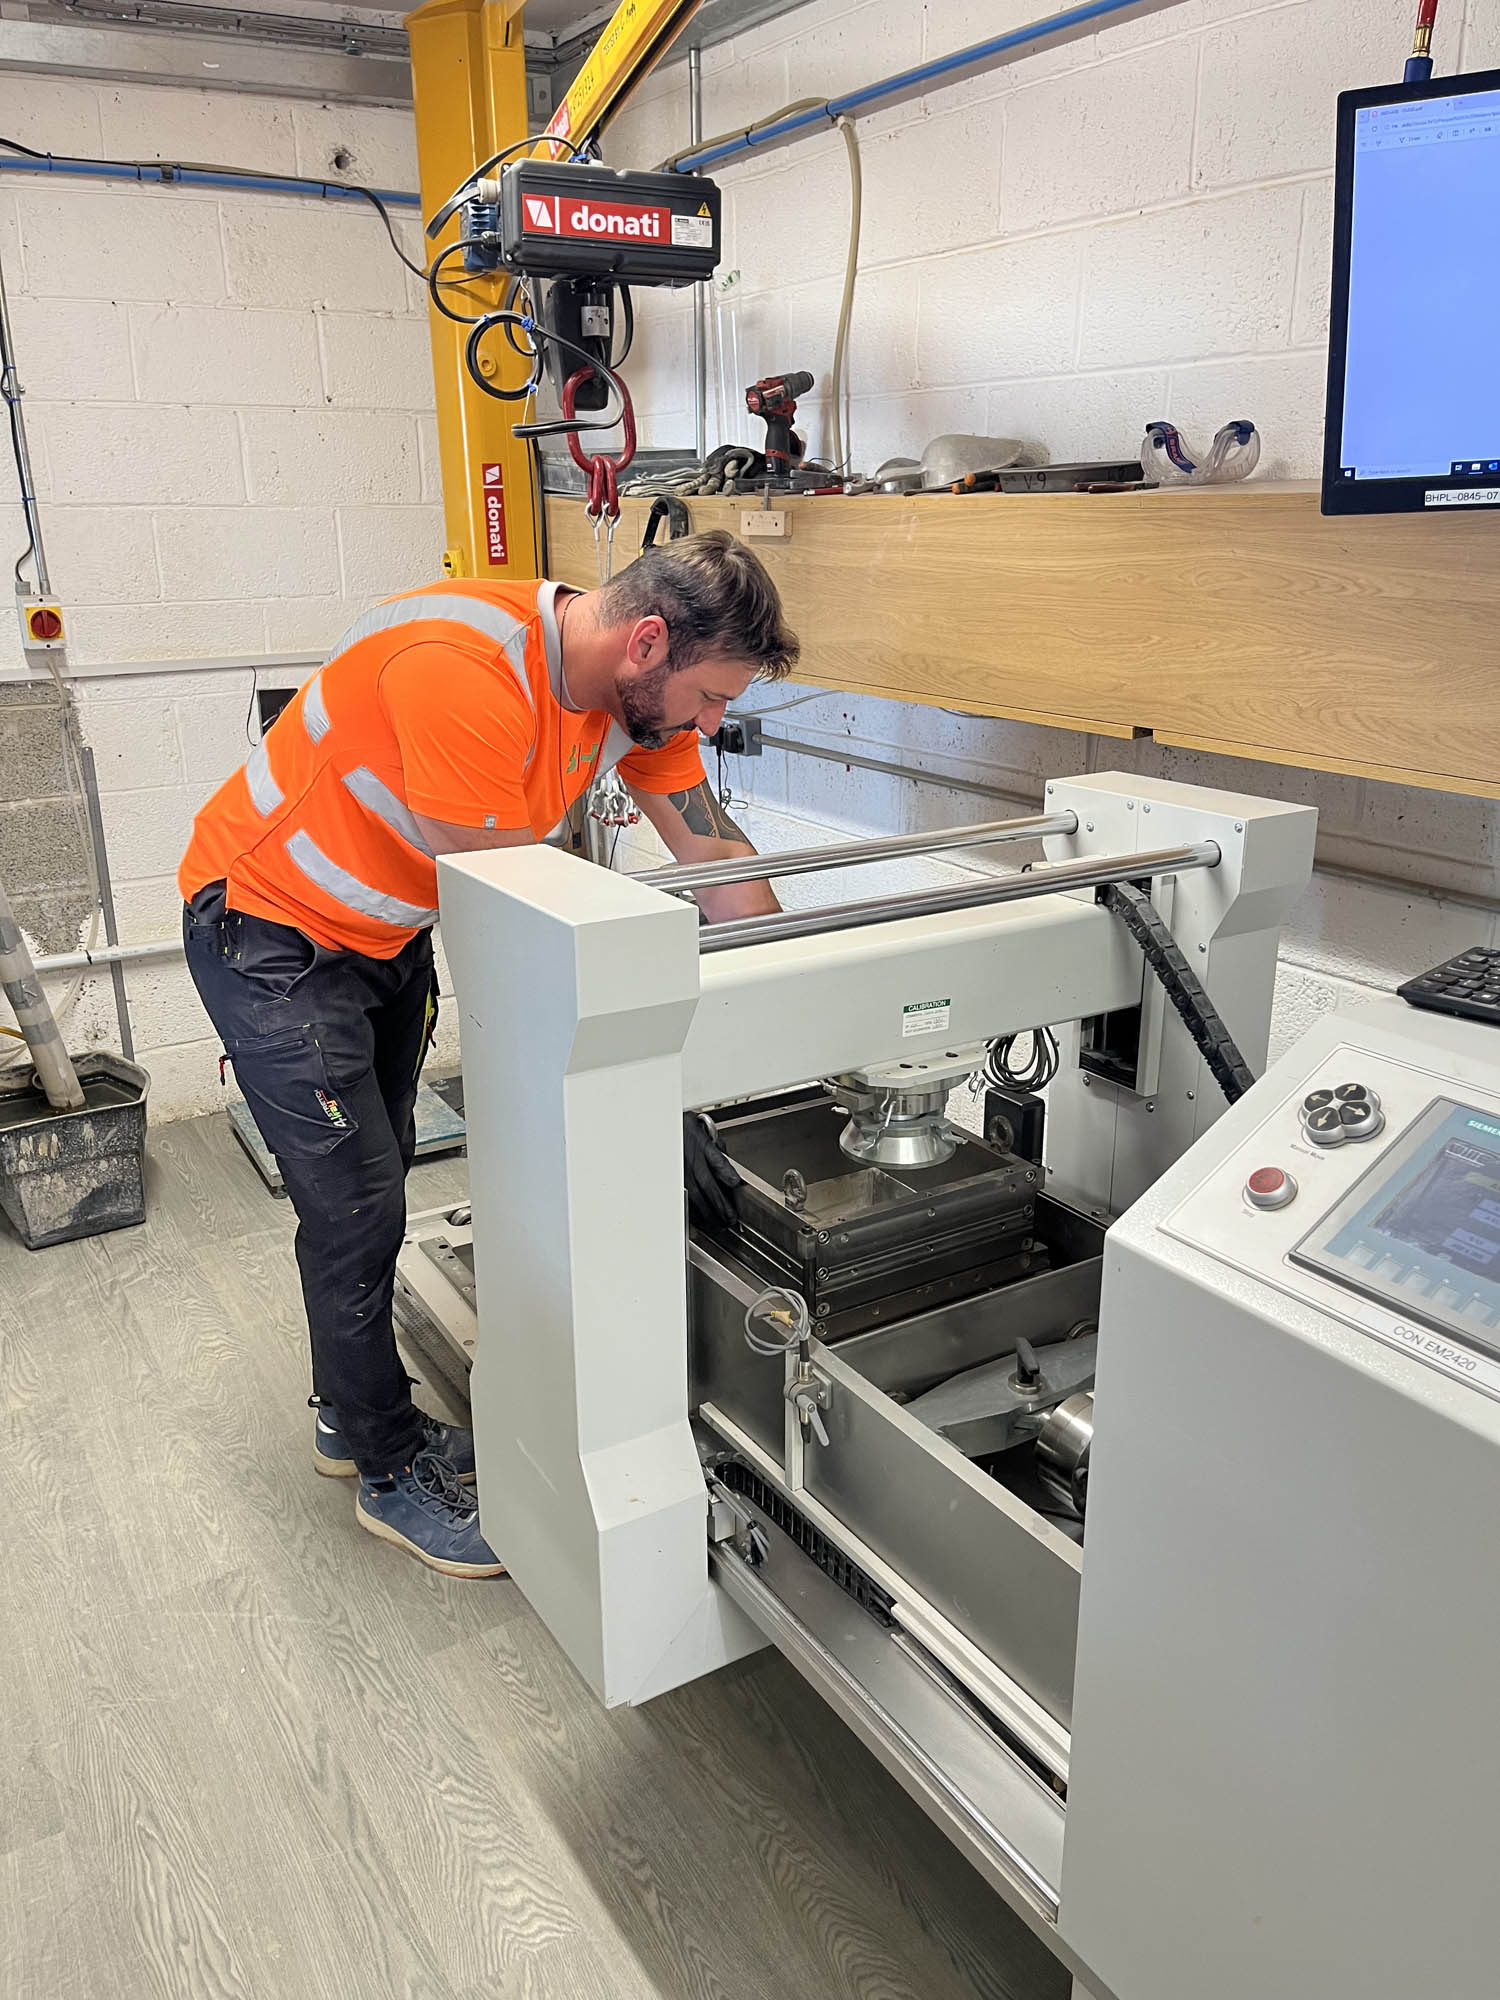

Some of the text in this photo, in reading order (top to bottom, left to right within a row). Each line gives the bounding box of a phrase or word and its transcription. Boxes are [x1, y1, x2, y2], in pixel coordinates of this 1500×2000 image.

[571, 205, 660, 238] donati
[1425, 491, 1498, 503] BHPL-0845-07
[487, 496, 505, 557] donati
[908, 1000, 946, 1012] CALIBRATION
[1393, 1325, 1477, 1371] CON EM2420
